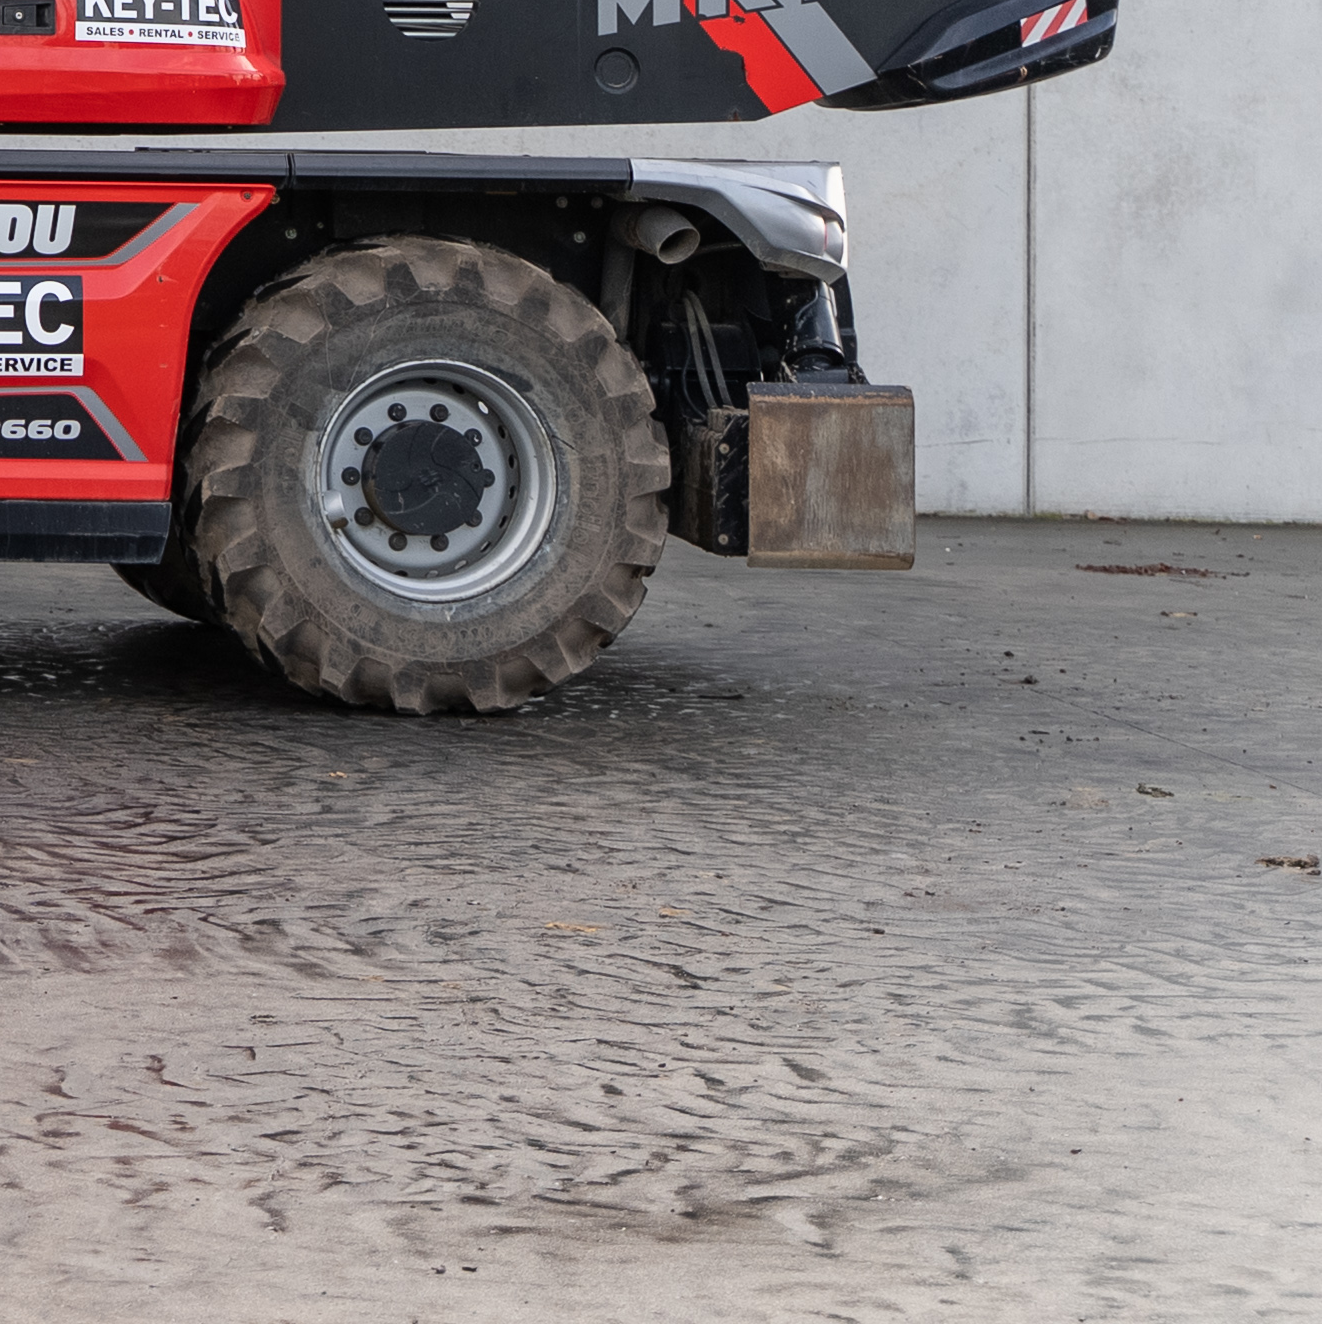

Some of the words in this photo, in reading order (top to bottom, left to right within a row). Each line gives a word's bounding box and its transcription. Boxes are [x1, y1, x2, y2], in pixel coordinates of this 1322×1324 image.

[86, 26, 124, 36] SALES
[139, 28, 185, 39] RENTAL
[197, 30, 241, 42] SERVICE
